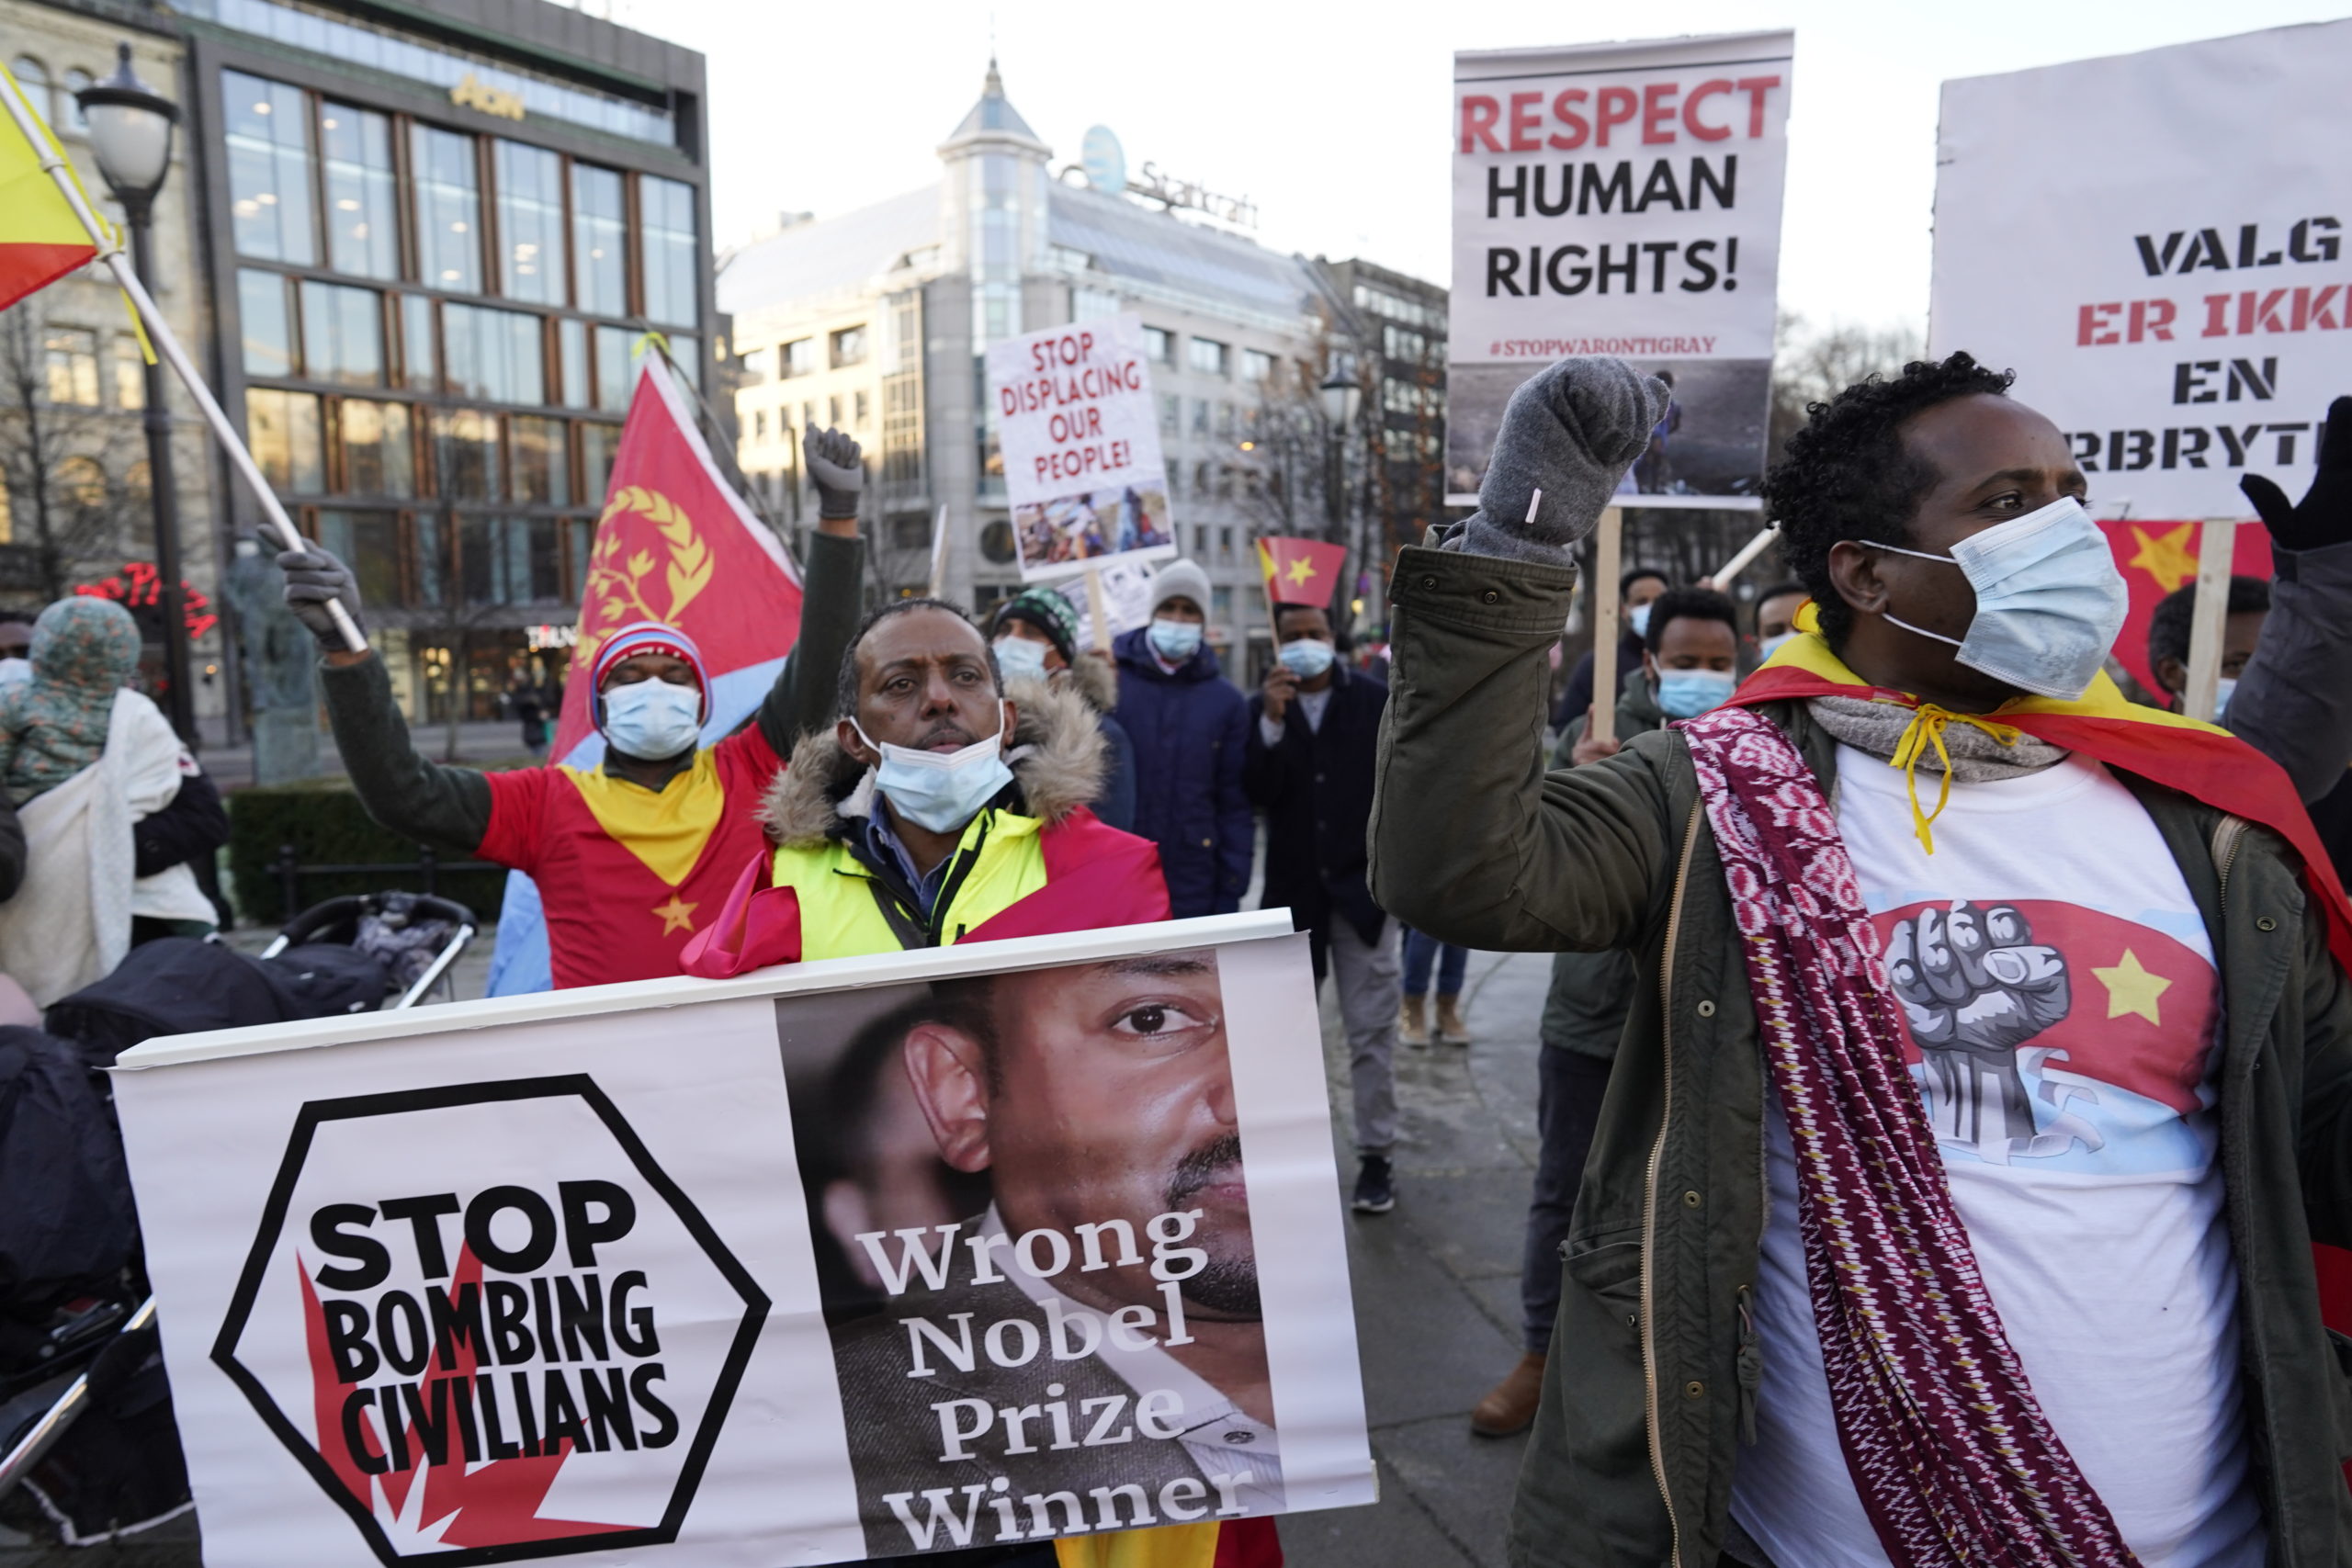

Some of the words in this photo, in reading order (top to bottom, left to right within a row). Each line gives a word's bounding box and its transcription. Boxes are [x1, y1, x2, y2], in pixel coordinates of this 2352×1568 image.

[1460, 75, 1781, 154] RESPECT
[1487, 154, 1738, 219] HUMAN
[1486, 237, 1739, 298] RIGHTS!
[2134, 216, 2342, 276] VALG
[1032, 333, 1093, 372] STOP
[1489, 336, 1716, 356] #STOPWARONTIGRAY
[2076, 299, 2177, 346] ER
[1001, 361, 1141, 416] DISPLACING
[2172, 356, 2278, 405] EN
[1049, 407, 1103, 444] OUR
[2063, 422, 2326, 472] RBRYT
[1035, 440, 1131, 483] PEOPLE!
[310, 1179, 637, 1292] STOP
[855, 1208, 1208, 1296] Wrong
[322, 1270, 661, 1384] BOMBING
[899, 1280, 1194, 1378] Nobel
[341, 1362, 679, 1475] CIVILIANS
[931, 1383, 1187, 1462] Prize
[882, 1470, 1254, 1550] Winner
